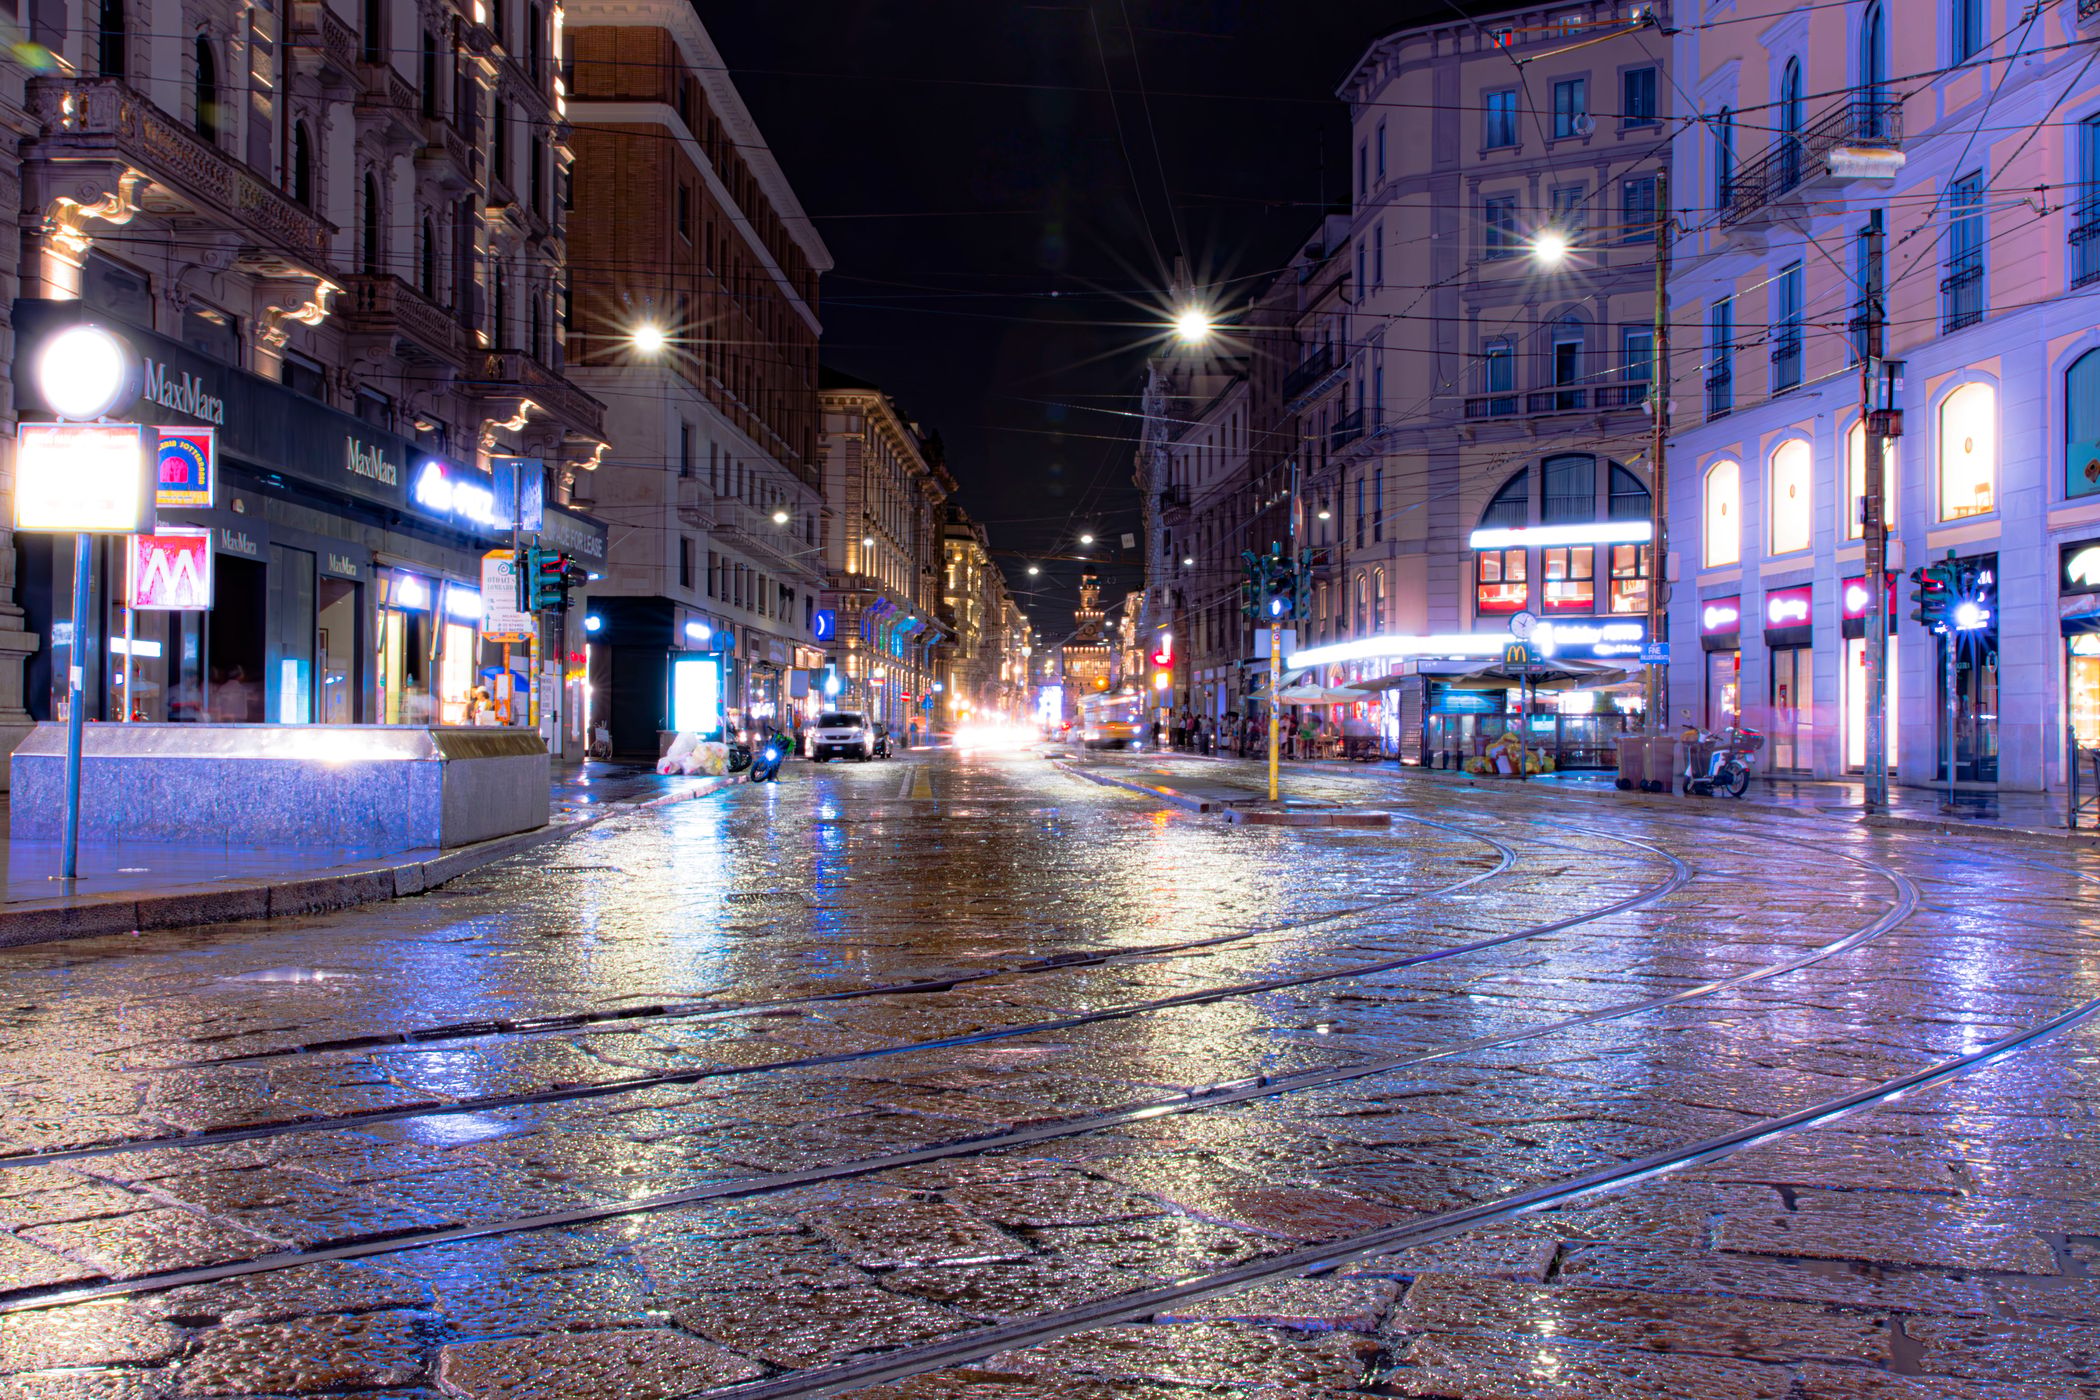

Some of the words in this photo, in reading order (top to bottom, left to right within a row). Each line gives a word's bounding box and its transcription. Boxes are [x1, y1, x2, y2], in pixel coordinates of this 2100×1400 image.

[144, 357, 223, 424] MaxMara
[346, 436, 397, 486] MaxMara
[221, 528, 257, 555] MaxMara
[585, 534, 602, 558] LEASE
[328, 553, 357, 576] MaxMara
